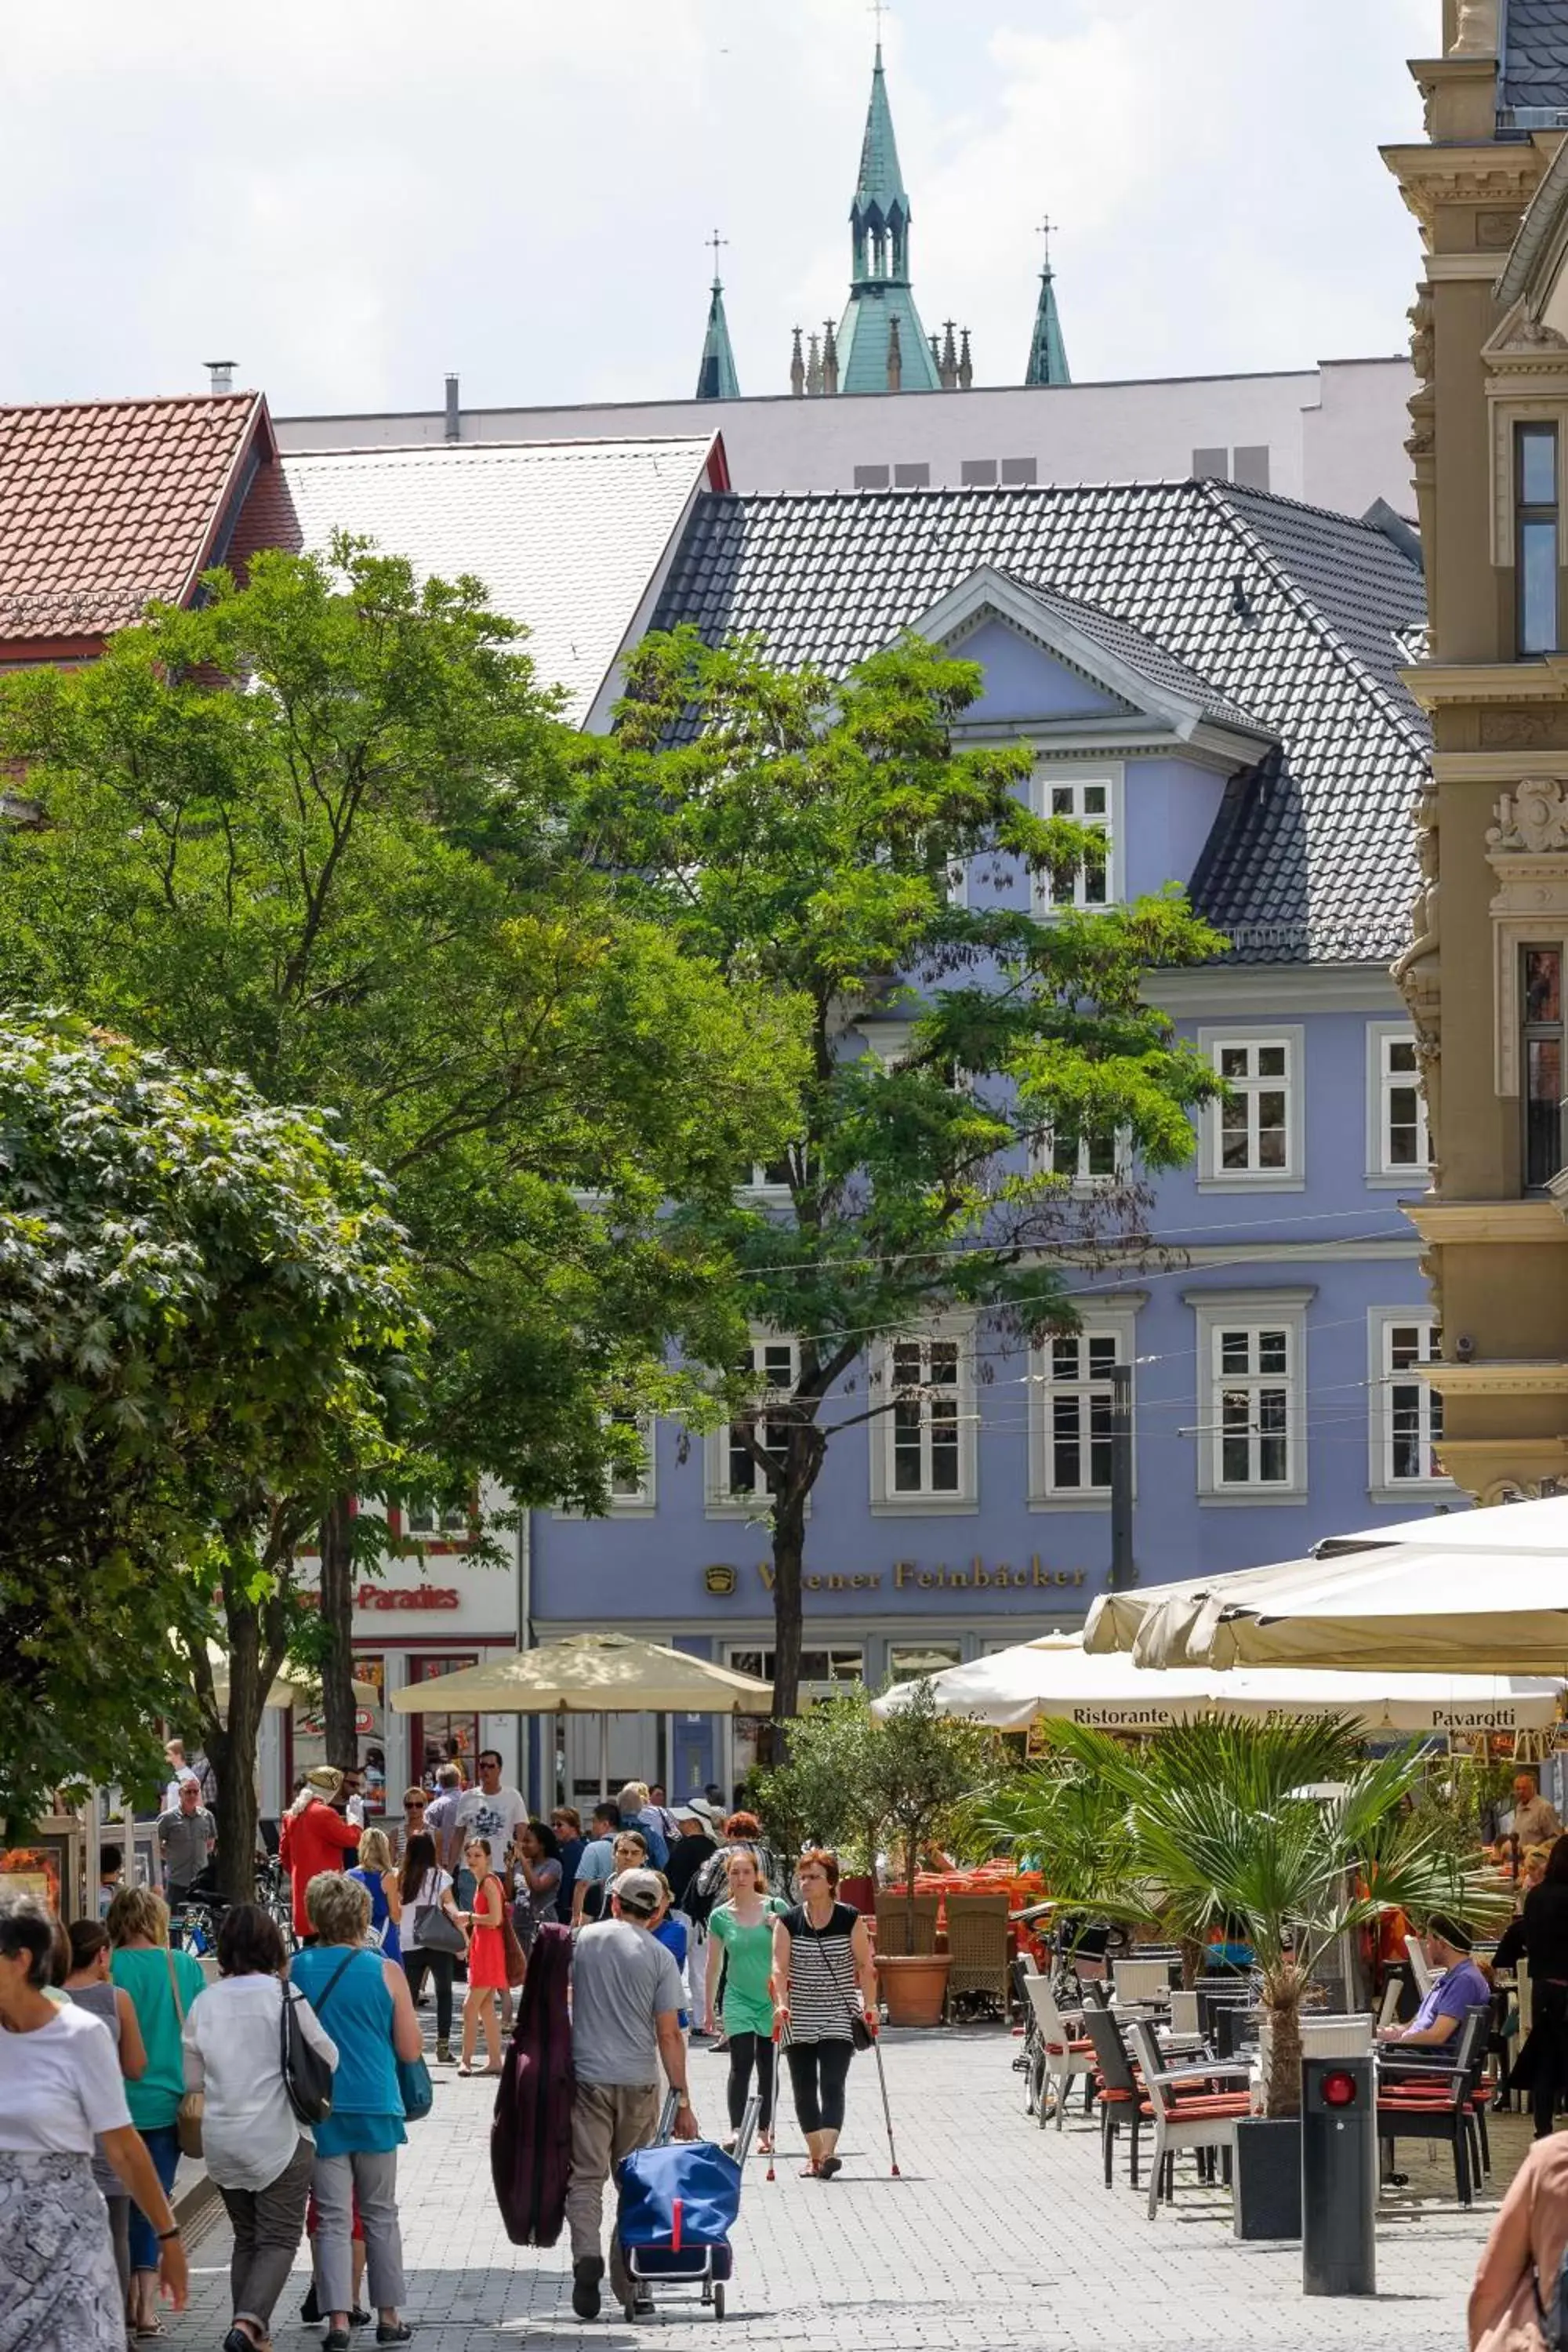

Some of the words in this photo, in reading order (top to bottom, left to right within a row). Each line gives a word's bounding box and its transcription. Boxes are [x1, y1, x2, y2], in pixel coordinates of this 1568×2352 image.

[894, 1554, 1086, 1587] Feinbäcker
[1073, 1707, 1169, 1724] Ristorante
[1432, 1708, 1515, 1726] Pavarotti
